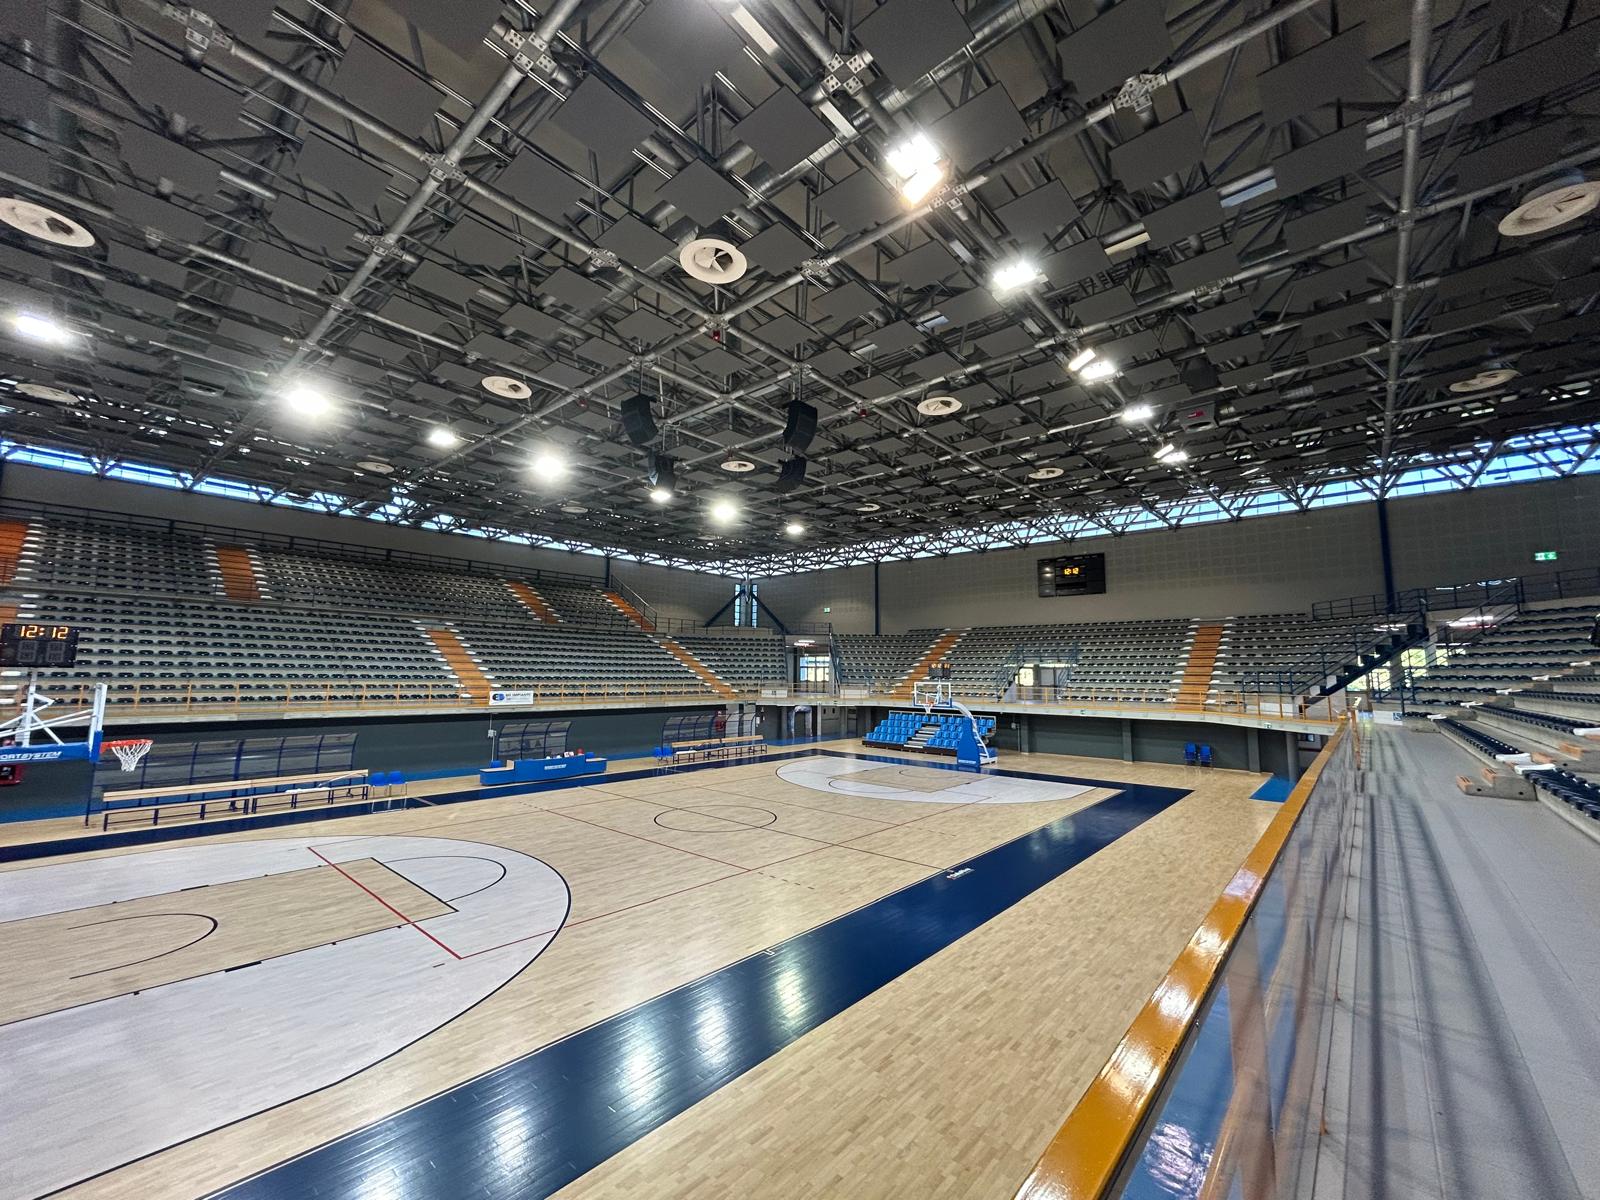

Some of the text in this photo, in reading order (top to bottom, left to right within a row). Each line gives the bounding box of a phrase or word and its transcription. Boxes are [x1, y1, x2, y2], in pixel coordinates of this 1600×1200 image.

[1064, 567, 1079, 575] 12:12
[20, 625, 69, 639] 12:12
[0, 751, 62, 760] ORTSYSTEM
